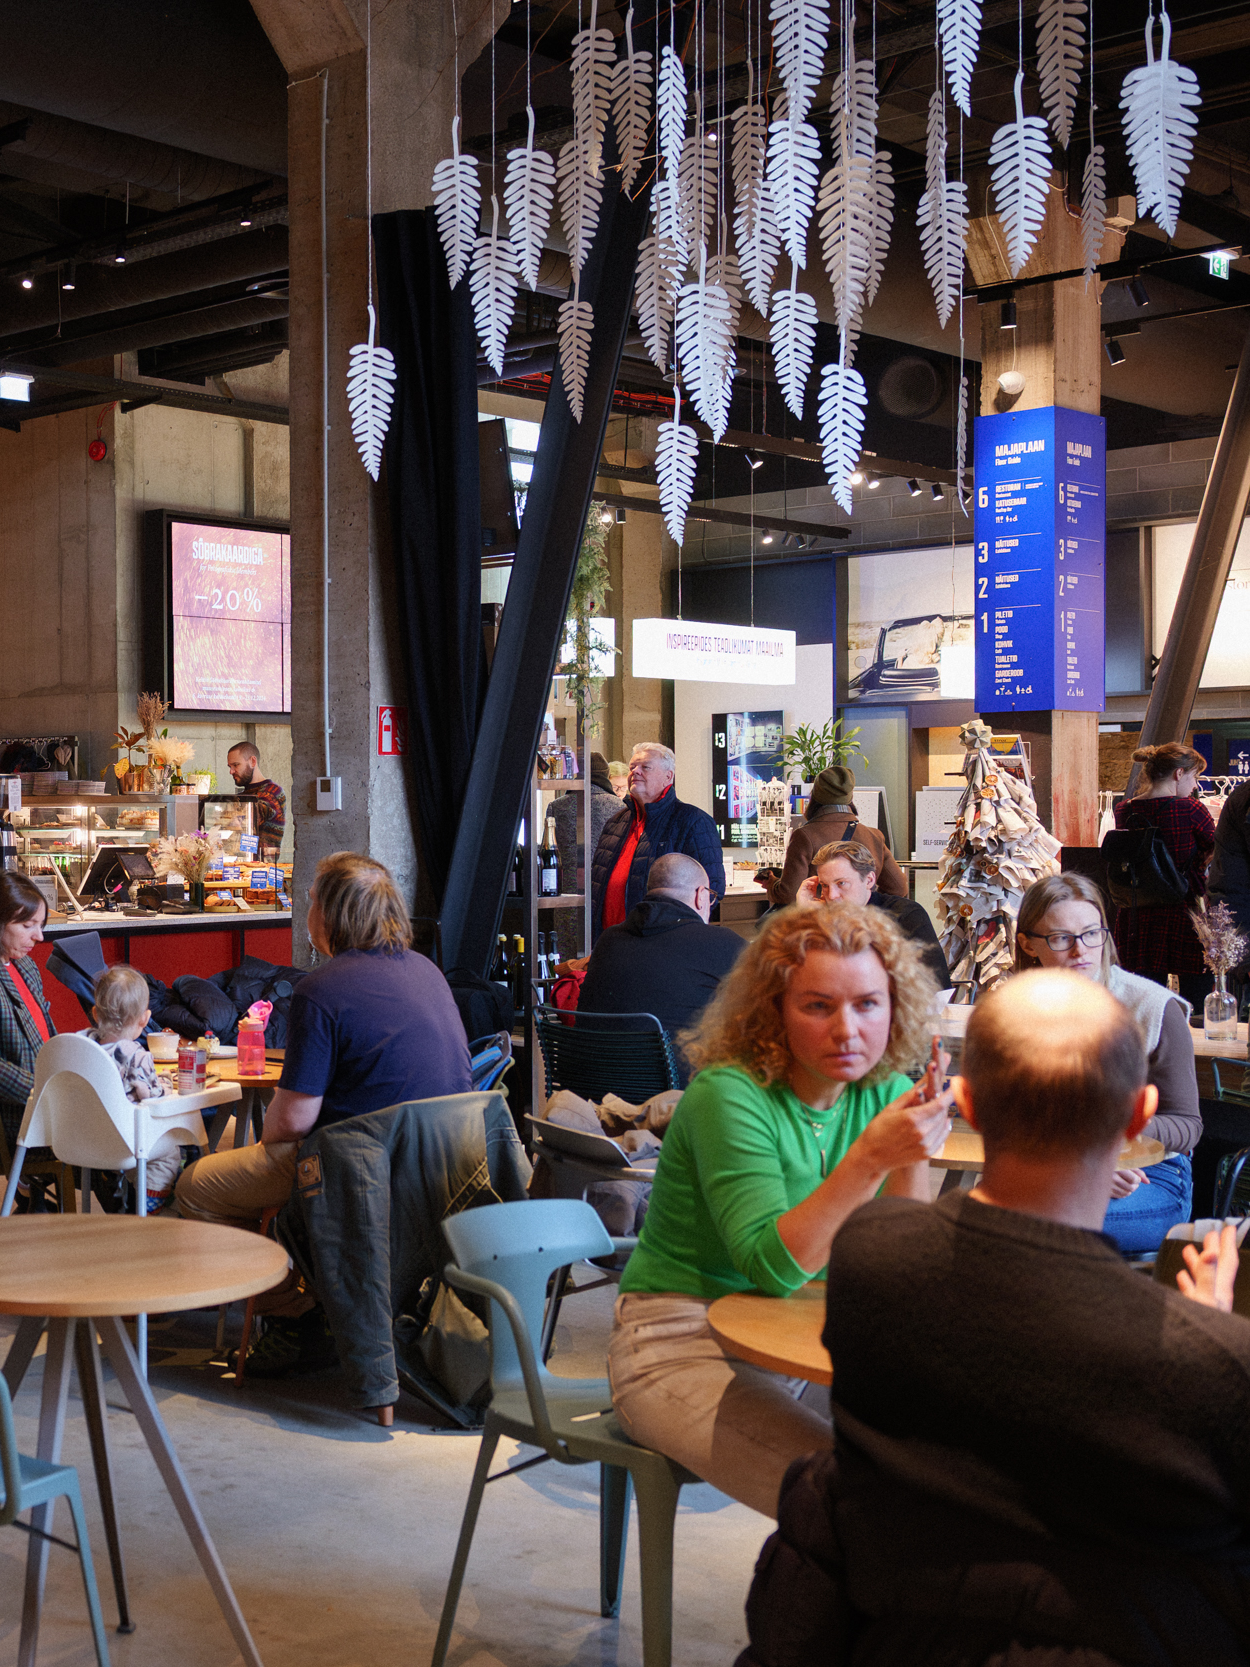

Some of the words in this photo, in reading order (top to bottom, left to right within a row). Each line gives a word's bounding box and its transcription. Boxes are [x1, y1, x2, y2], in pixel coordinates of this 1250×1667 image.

[995, 439, 1045, 457] MAJAPLAAN
[978, 486, 989, 508] 6
[1059, 482, 1065, 504] 6
[192, 537, 264, 566] SÕBRAKAARDIGA
[978, 541, 989, 563] 3
[1059, 538, 1065, 560] 3
[978, 577, 989, 599] 2
[1059, 574, 1065, 596] 2
[980, 612, 988, 633] 1
[995, 610, 1013, 619] PILETID
[1060, 611, 1065, 632] 1
[995, 625, 1009, 634] POOD
[666, 632, 712, 653] INSPIREERIDES
[995, 655, 1018, 663] TUALETID
